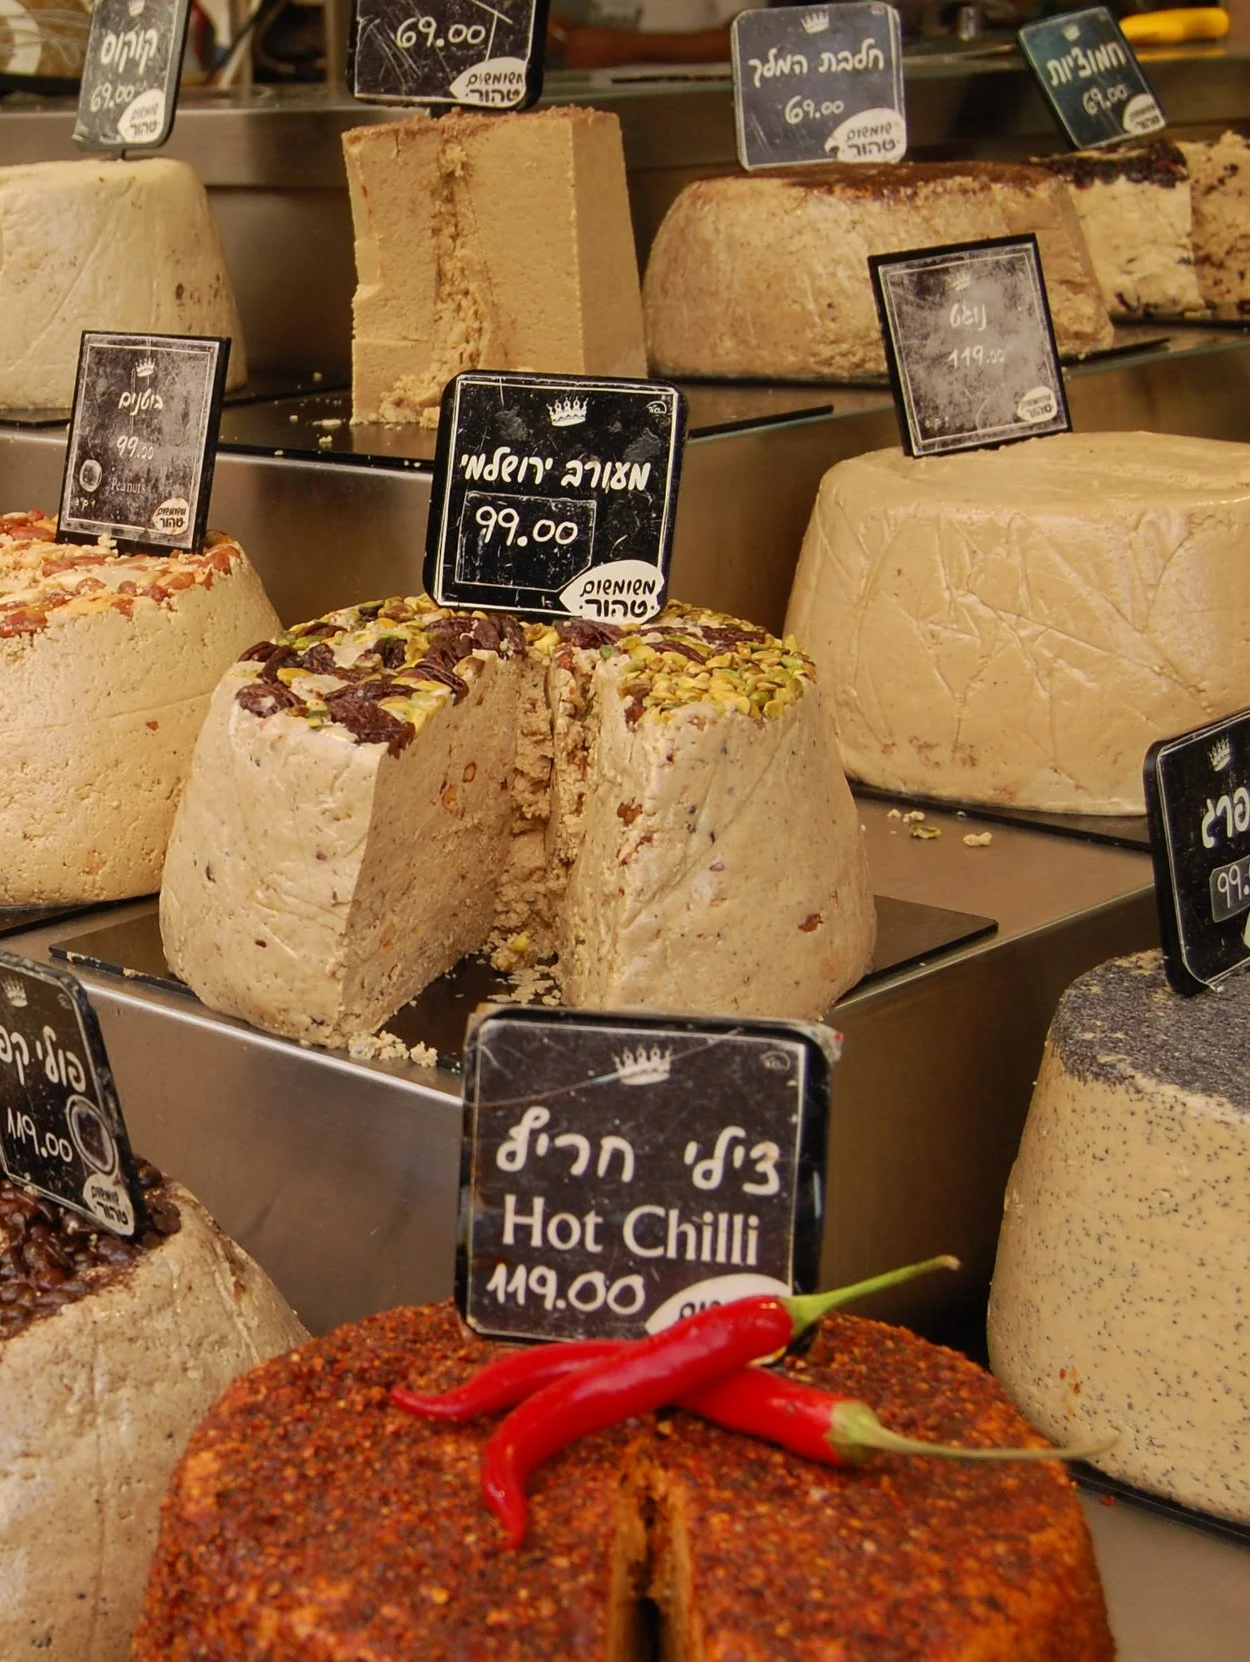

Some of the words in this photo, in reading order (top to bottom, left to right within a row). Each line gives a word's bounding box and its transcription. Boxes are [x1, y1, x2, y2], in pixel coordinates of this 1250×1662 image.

[396, 16, 486, 48] 69.00
[100, 28, 158, 75] קוקוס
[748, 47, 808, 89] המלך
[818, 38, 885, 73] חלבת
[1046, 41, 1127, 87] חמוציות
[90, 82, 135, 112] 69.00
[469, 88, 520, 103] טהור
[785, 95, 845, 125] 69.00
[1082, 83, 1128, 117] 69.00
[848, 139, 896, 157] טהור
[950, 303, 987, 331] נוגט
[118, 388, 164, 416] בוטנים
[117, 435, 155, 460] 99.00
[460, 446, 553, 485] ירושלמי
[561, 459, 651, 491] מעורב
[110, 477, 146, 494] Peanuts
[160, 517, 184, 528] טהור
[475, 505, 578, 547] 99.00
[579, 578, 656, 597] משומשום
[584, 599, 649, 618] טהור
[1217, 864, 1250, 909] 99.
[36, 1025, 86, 1093] פולי
[7, 1107, 72, 1163] 119.00
[496, 1106, 635, 1183] חריף
[684, 1126, 781, 1196] צילי
[502, 1194, 604, 1253] Hot
[623, 1204, 760, 1266] Chilli
[486, 1262, 646, 1316] 119.00
